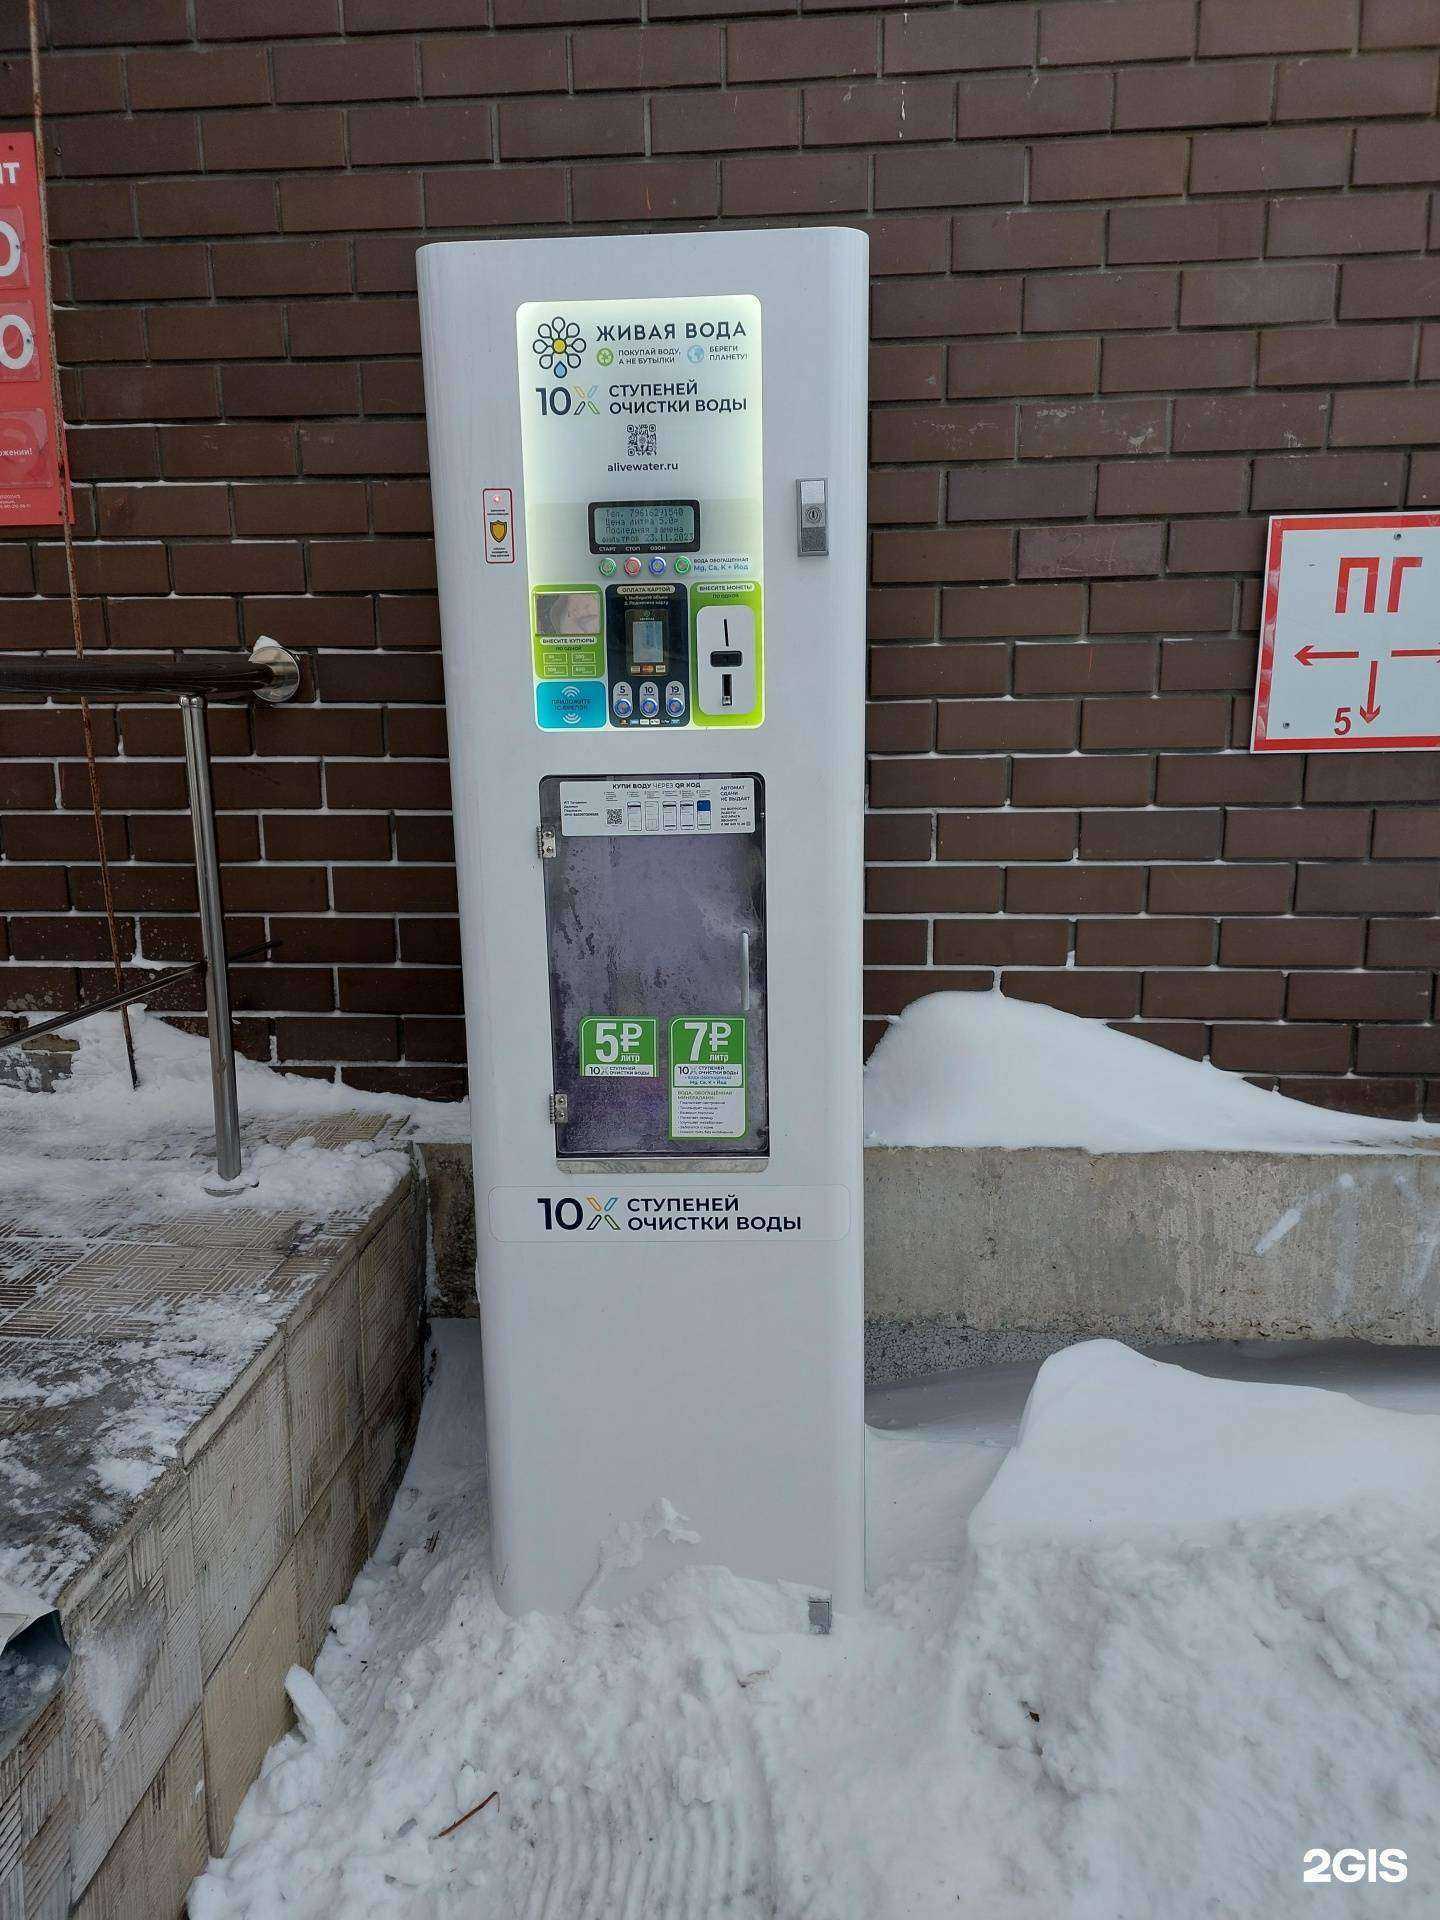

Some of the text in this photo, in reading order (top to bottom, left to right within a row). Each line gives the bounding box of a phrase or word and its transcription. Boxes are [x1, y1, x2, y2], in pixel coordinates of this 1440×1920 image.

[596, 320, 746, 341] ЖИВАЯ ВОДА
[618, 347, 682, 356] ПОКУПАЙ ВОДУ,
[638, 356, 675, 364] БУТЫЛКИ
[608, 379, 698, 398] СТУПЕНЕЙ
[609, 398, 747, 415] ОЧИСТКИ ВОДЫ
[607, 461, 679, 473] alivewater.ru
[1335, 556, 1423, 613] ПГ
[619, 685, 626, 694] 5
[644, 686, 654, 694] 10
[670, 685, 680, 693] 19
[1334, 707, 1352, 736] 5
[620, 1053, 641, 1063] литр
[708, 1053, 729, 1063] литр
[627, 1194, 739, 1212] СТУПЕНЕЙ
[627, 1215, 801, 1232] ОЧИСТКИ ВОДЫ
